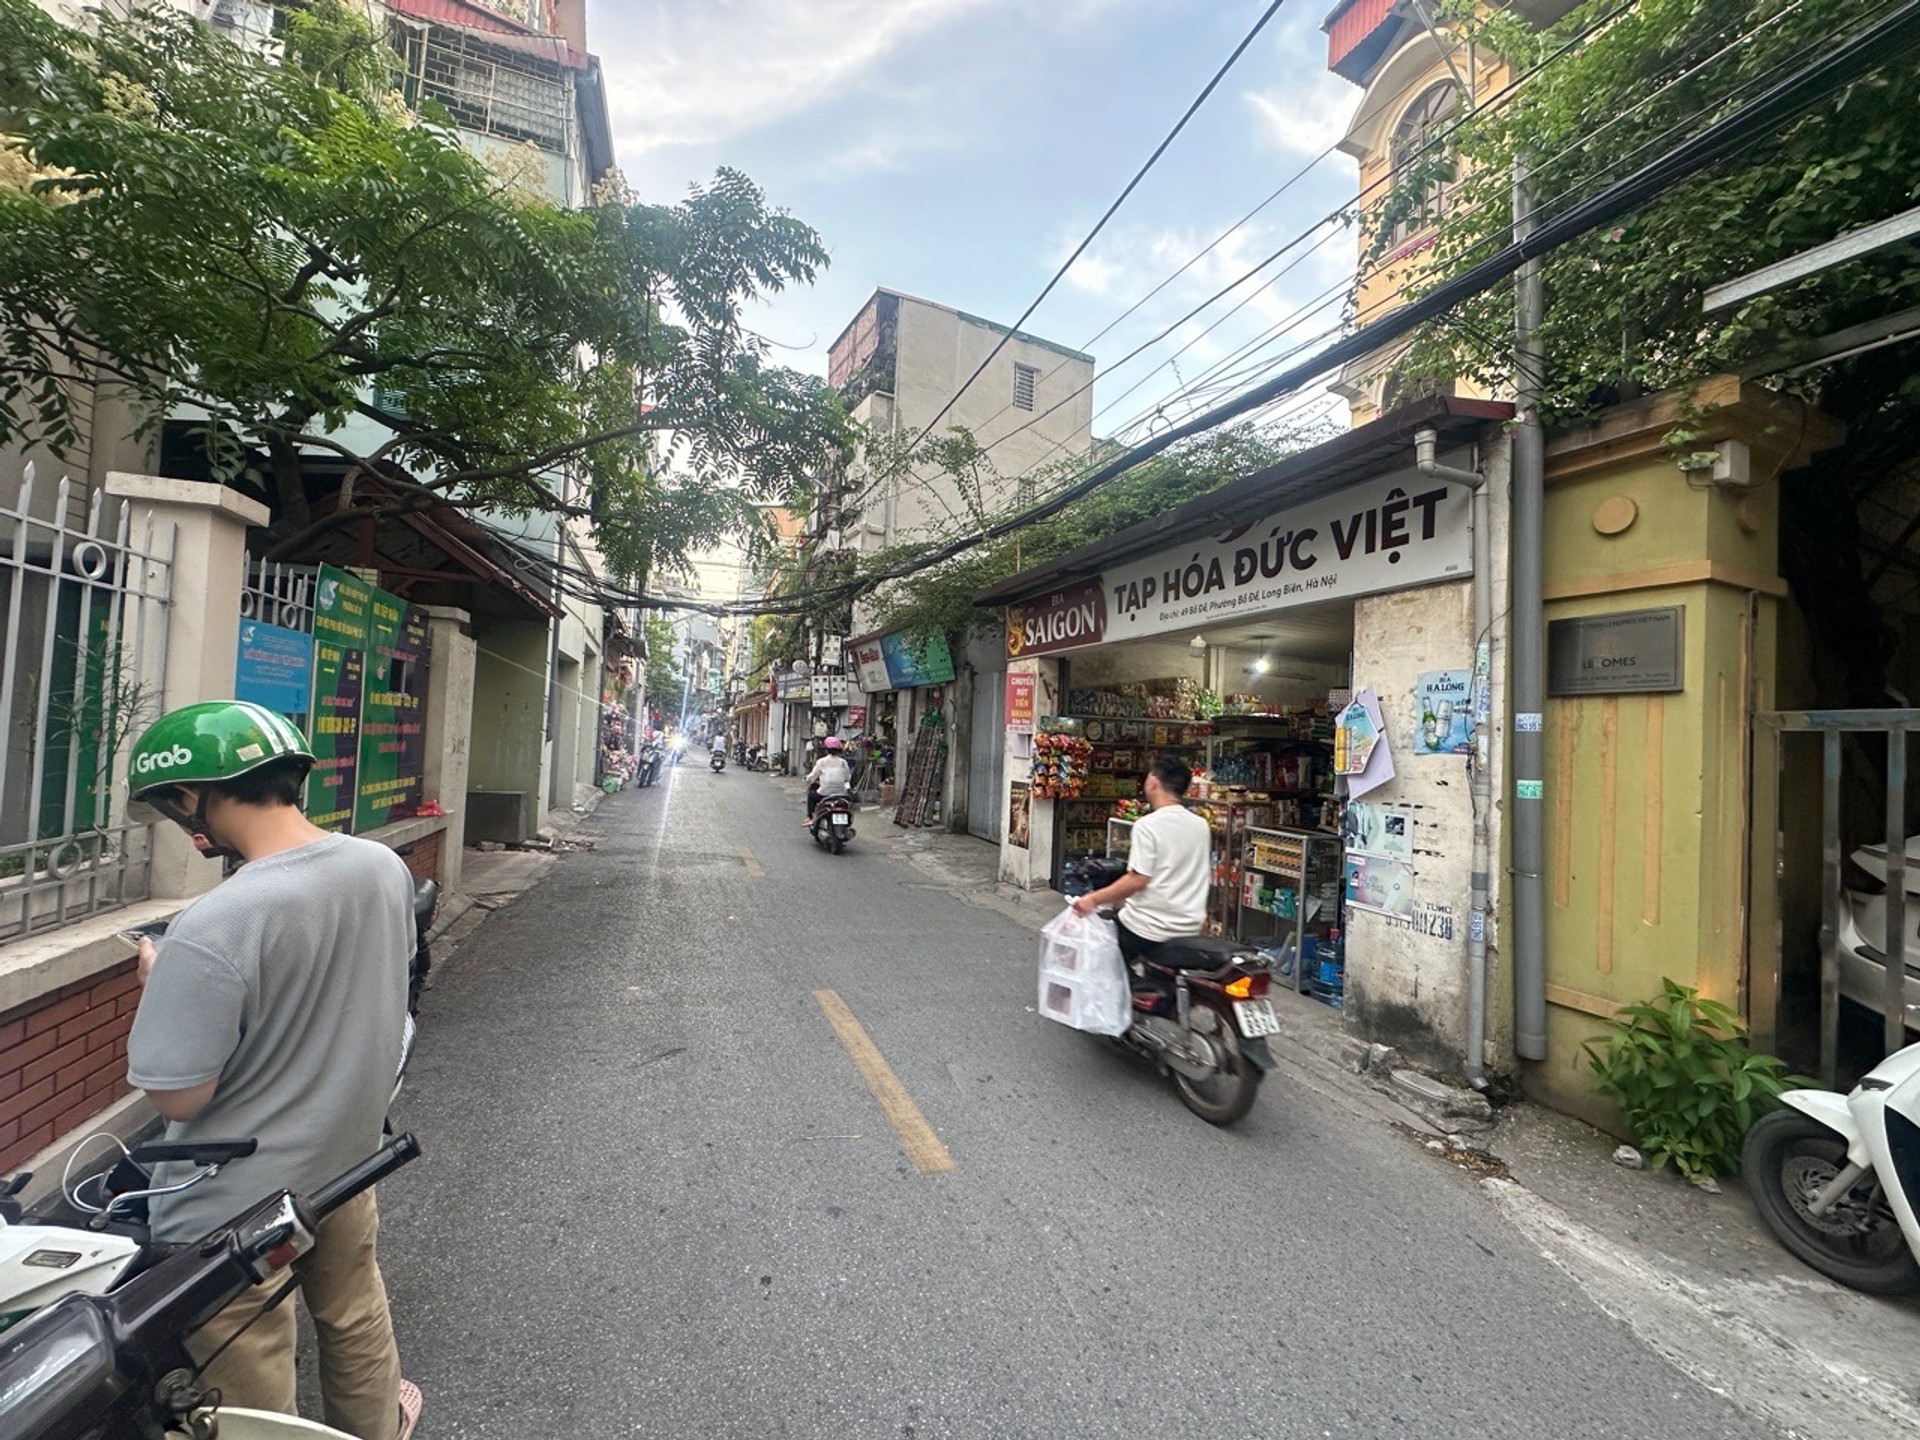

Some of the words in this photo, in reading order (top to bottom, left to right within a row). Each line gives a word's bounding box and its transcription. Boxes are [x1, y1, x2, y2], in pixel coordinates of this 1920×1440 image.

[1113, 576, 1157, 622] TẠP
[1162, 552, 1225, 604] HÓA
[1233, 525, 1318, 586] ĐỨC
[1329, 487, 1448, 564] VIỆT
[1262, 587, 1282, 602] Long
[1305, 577, 1319, 591] Hà
[1320, 573, 1338, 590] Nội
[1025, 601, 1096, 647] SAIGON
[136, 744, 192, 774] Grab
